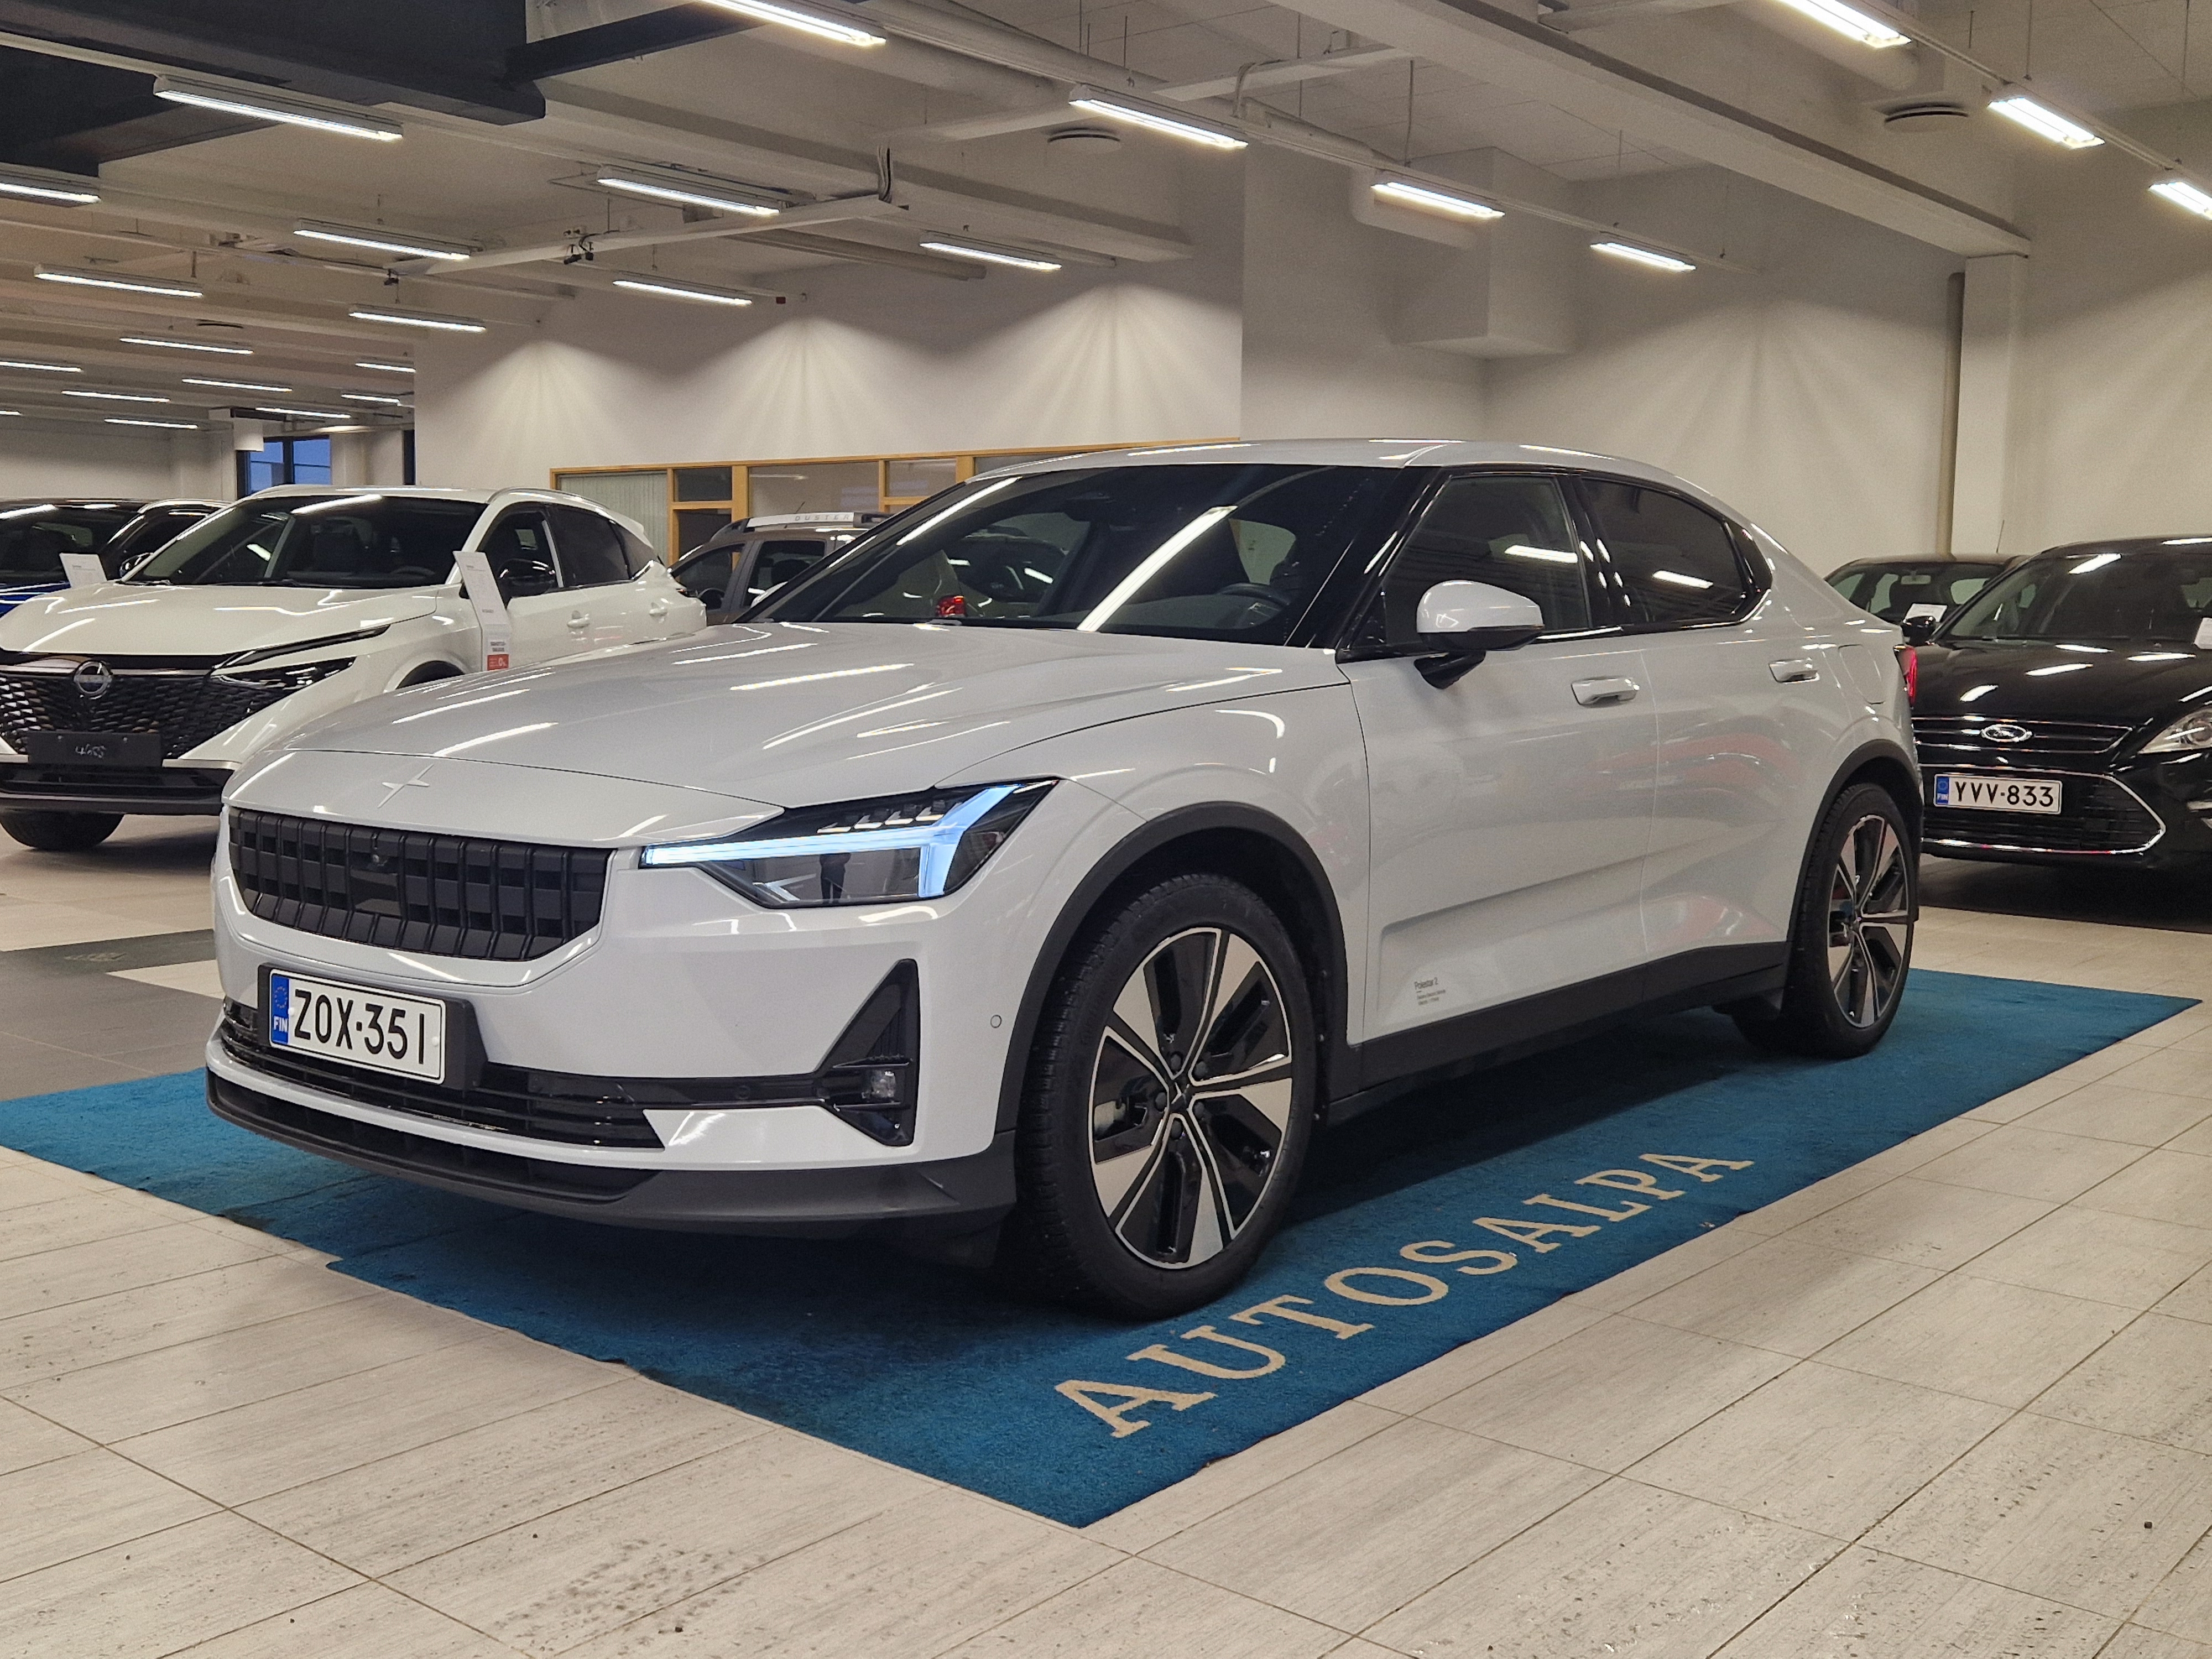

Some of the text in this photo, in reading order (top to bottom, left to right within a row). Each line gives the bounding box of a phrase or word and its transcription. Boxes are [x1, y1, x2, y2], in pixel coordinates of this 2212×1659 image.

[1955, 781, 2053, 807] YVV-833
[1434, 977, 1438, 985] 2
[274, 1016, 287, 1032] FIN
[294, 989, 424, 1064] ZOX-351
[1055, 1153, 1754, 1438] AUTOSALPA
